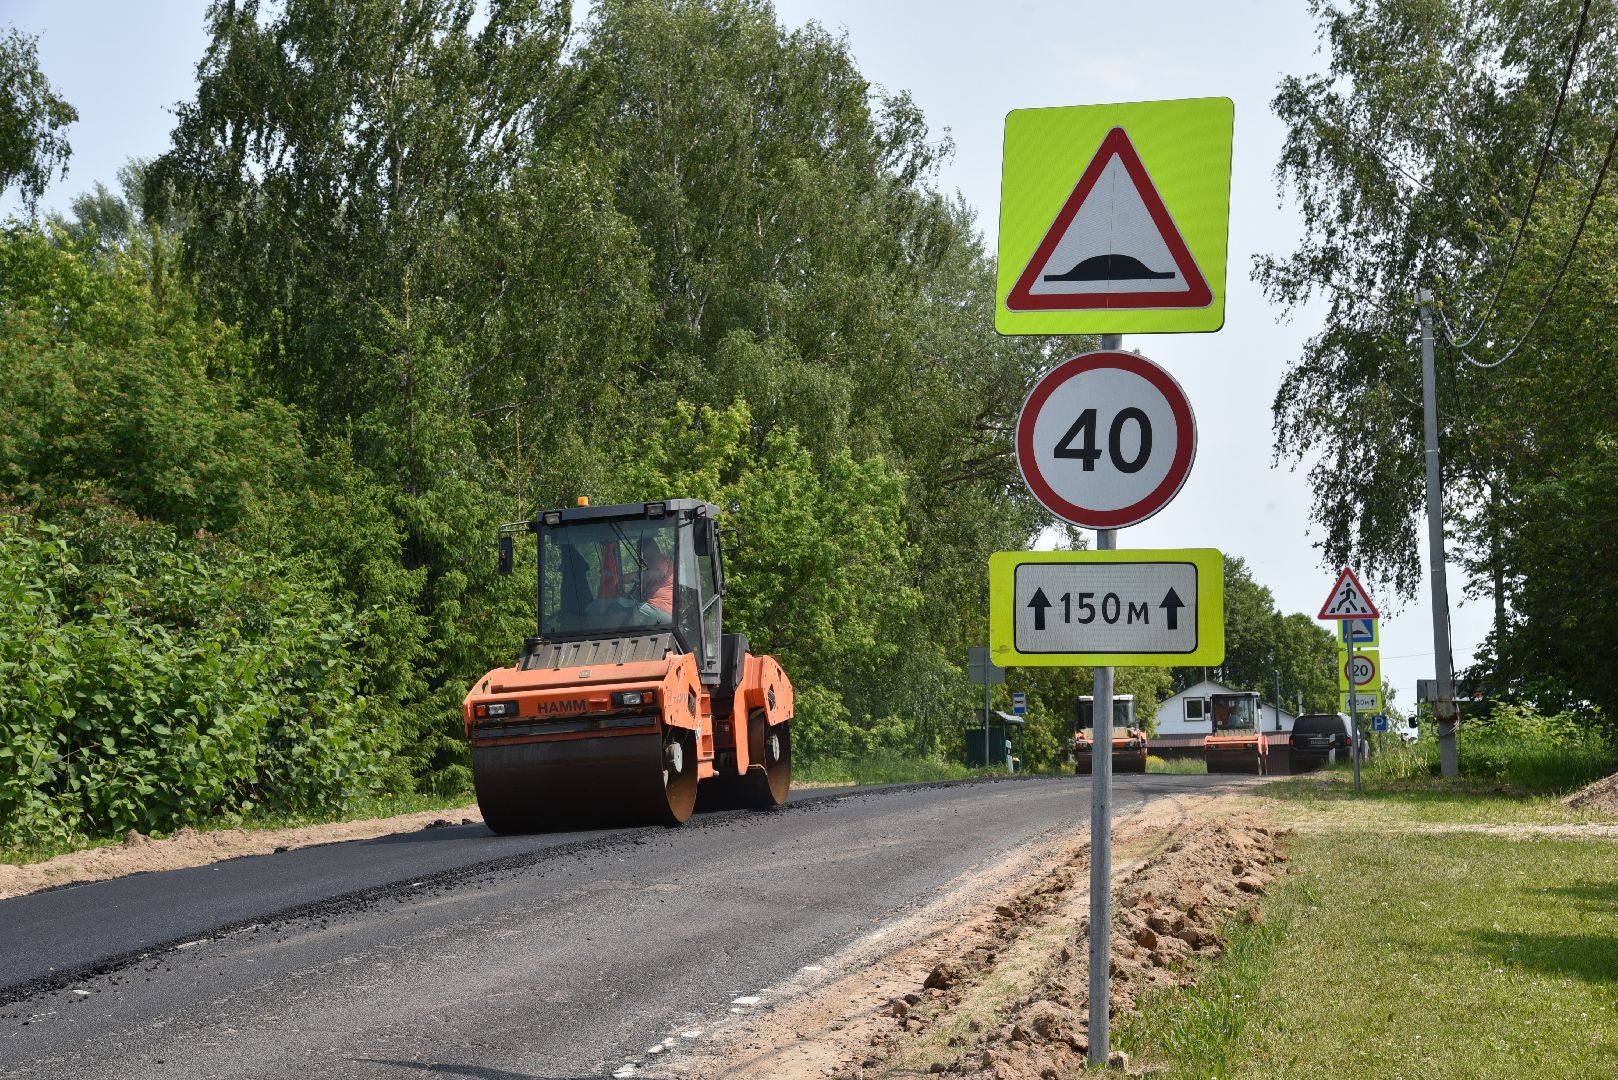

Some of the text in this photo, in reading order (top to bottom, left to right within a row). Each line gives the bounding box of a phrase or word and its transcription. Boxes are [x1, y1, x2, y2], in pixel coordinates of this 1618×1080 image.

[1054, 407, 1152, 473] 40
[1353, 665, 1368, 676] 20
[537, 699, 587, 714] HAMM
[1375, 717, 1384, 730] P
